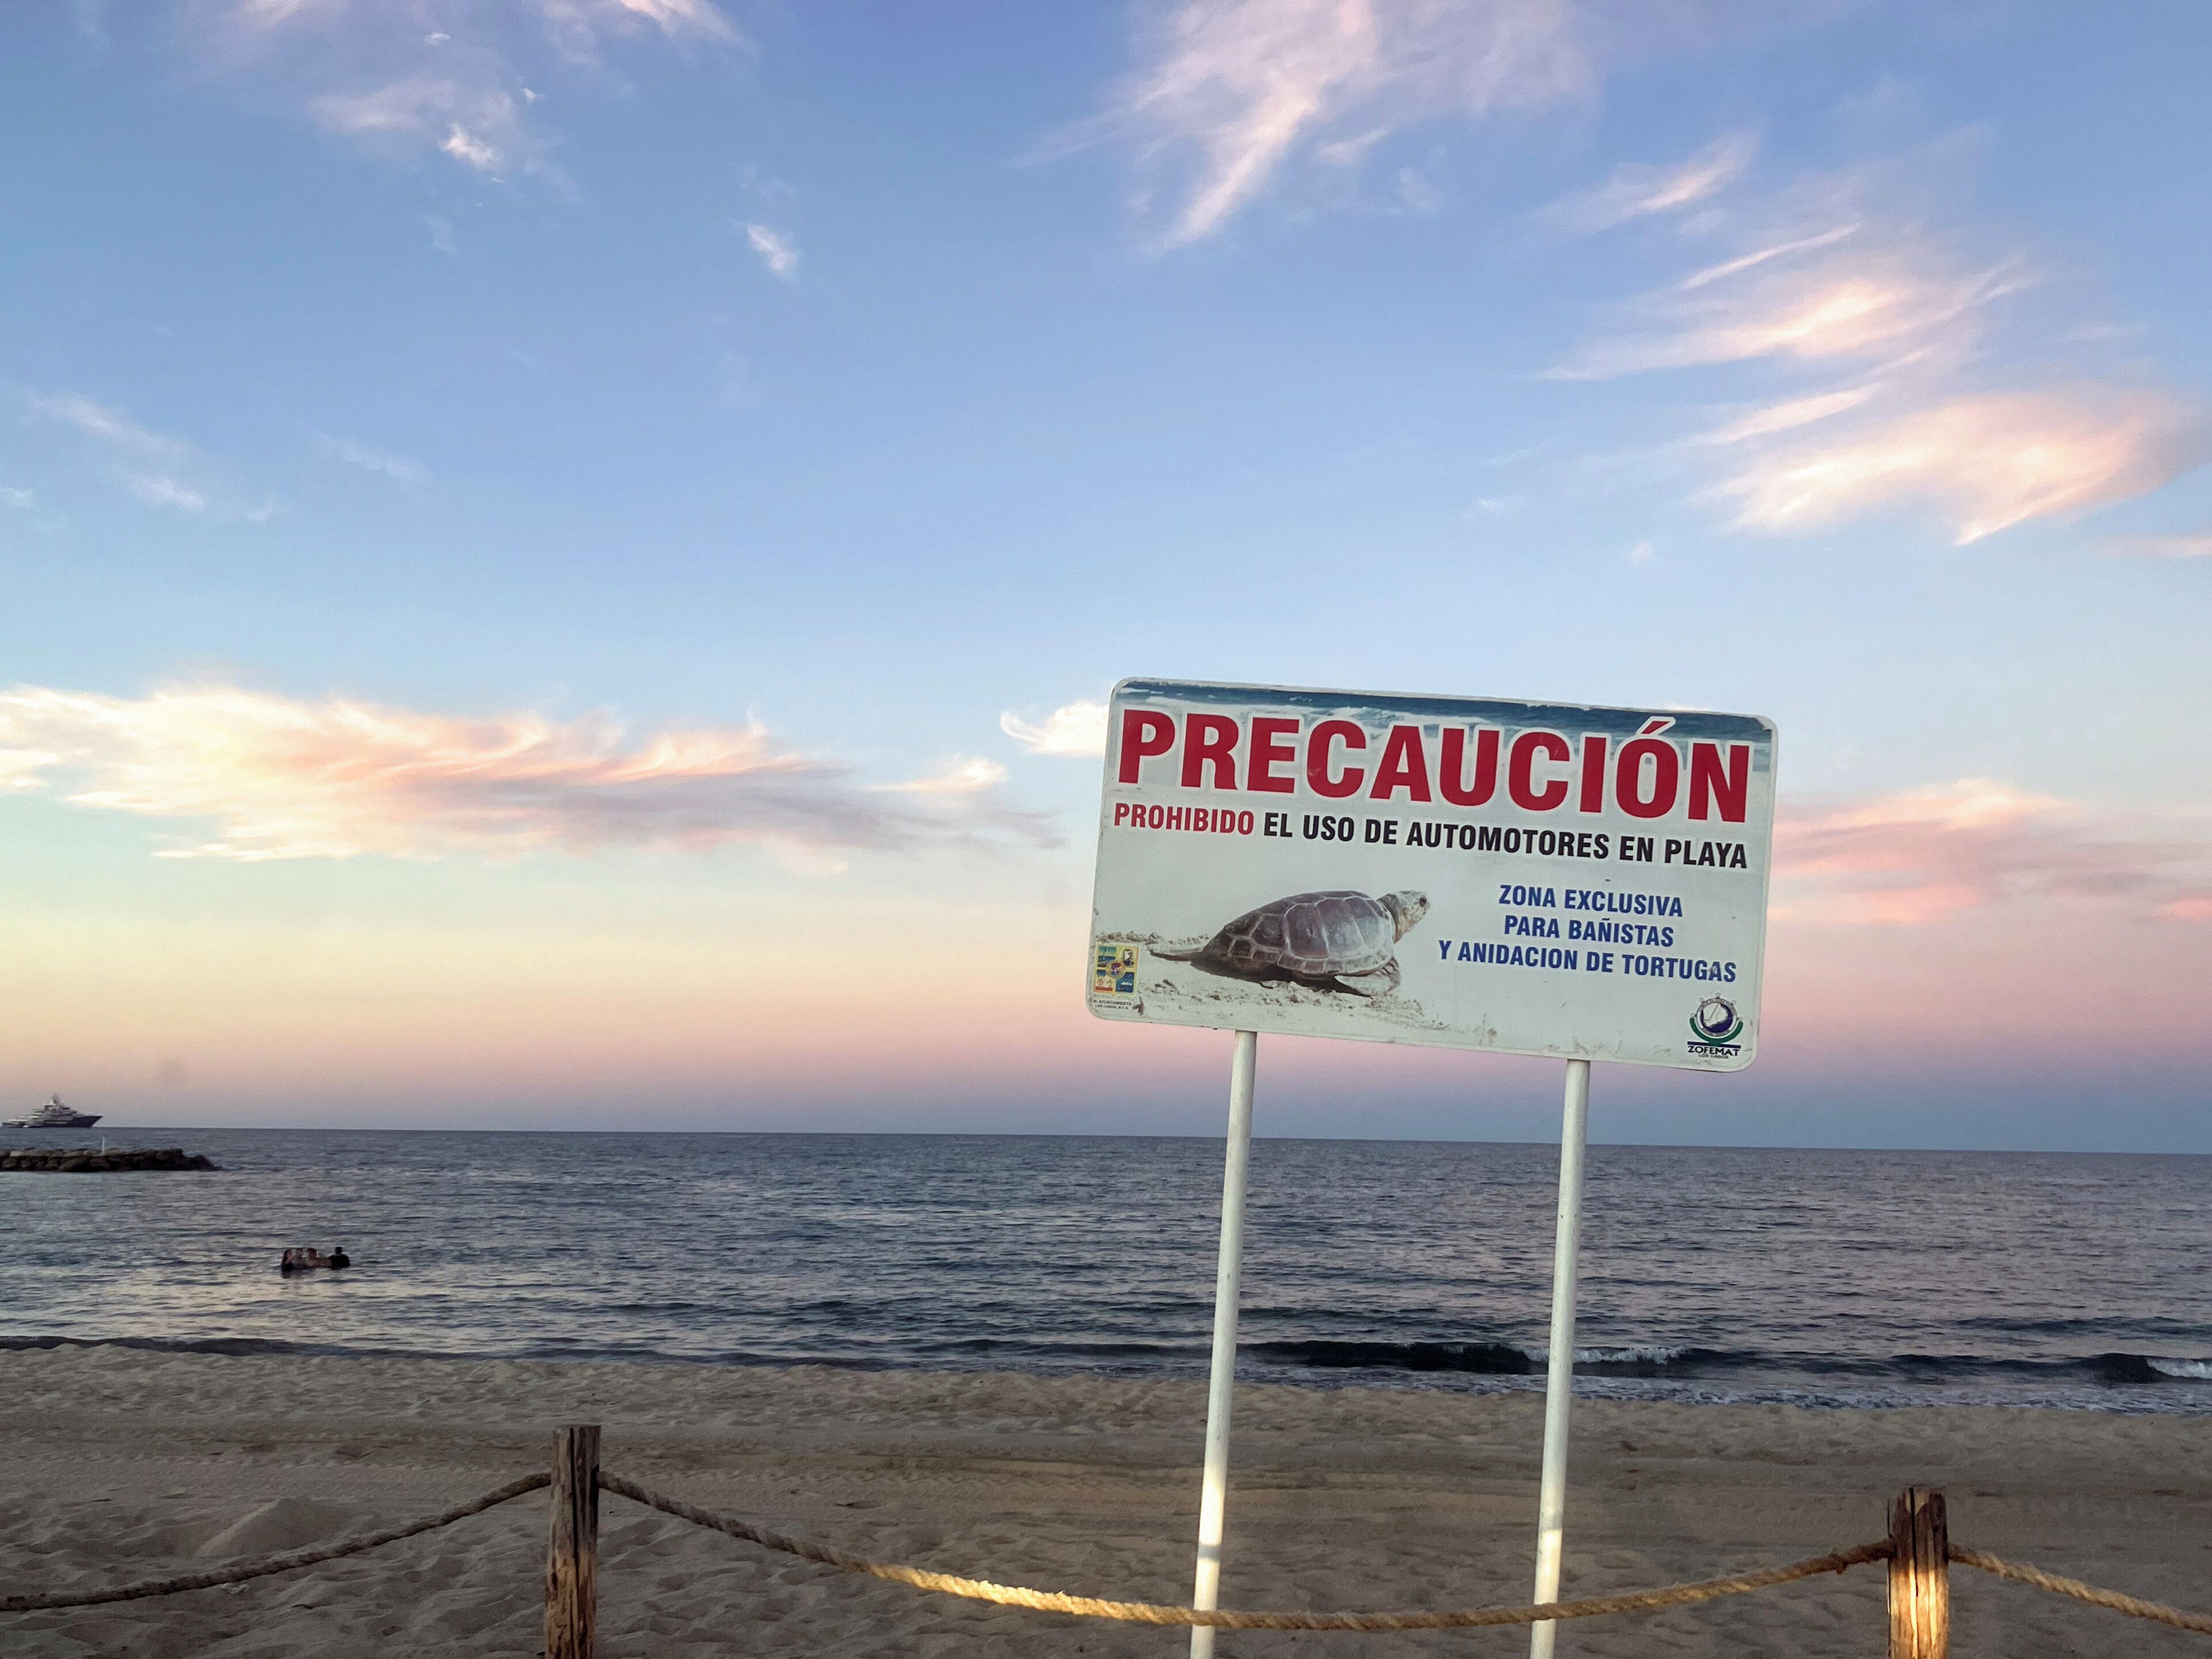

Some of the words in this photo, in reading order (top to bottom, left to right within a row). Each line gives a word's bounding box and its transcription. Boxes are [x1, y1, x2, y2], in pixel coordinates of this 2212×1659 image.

[1119, 709, 1750, 824] PRECAUCIÓN
[1114, 803, 1255, 836] PROHIBIDO
[1263, 812, 1293, 838] EL
[1302, 814, 1355, 843] USO
[1363, 818, 1399, 846] DE
[1405, 821, 1610, 860] AUTOMOTORES
[1619, 835, 1654, 863] EN
[1664, 838, 1748, 869] PLAYA
[1499, 884, 1556, 908] ZONA
[1563, 889, 1683, 918] EXCLUSIVA
[1504, 915, 1560, 938] PARA
[1568, 918, 1673, 948] BAÑISTAS
[1439, 940, 1451, 960] Y
[1457, 942, 1578, 970] ANIDACION
[1586, 951, 1614, 973] DE
[1622, 955, 1736, 983] TORTUGAS
[1687, 1046, 1740, 1056] ZOFEMAT
